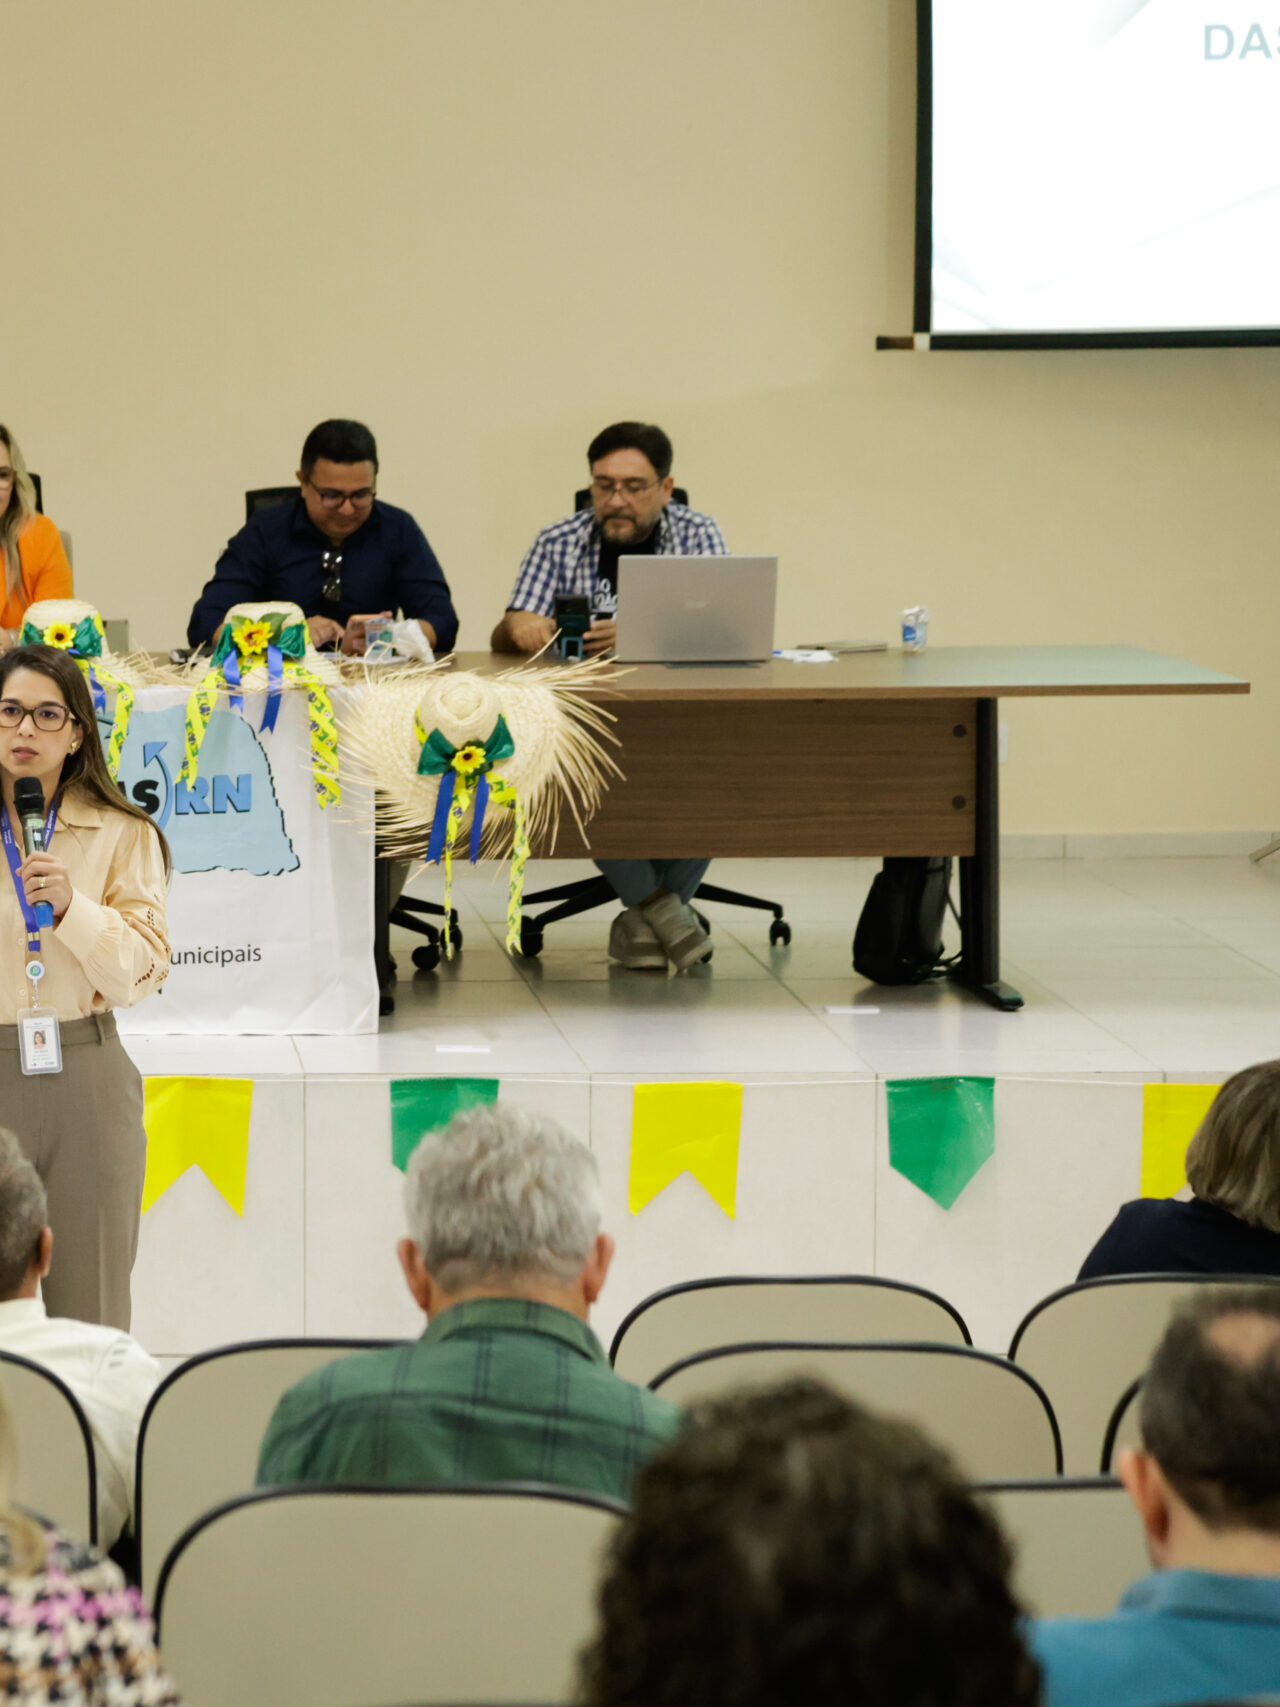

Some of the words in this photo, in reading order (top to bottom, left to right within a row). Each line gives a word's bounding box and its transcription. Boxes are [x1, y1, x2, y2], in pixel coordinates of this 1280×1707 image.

[1204, 22, 1280, 60] DA
[175, 774, 252, 815] RN
[170, 944, 262, 968] unicipais
